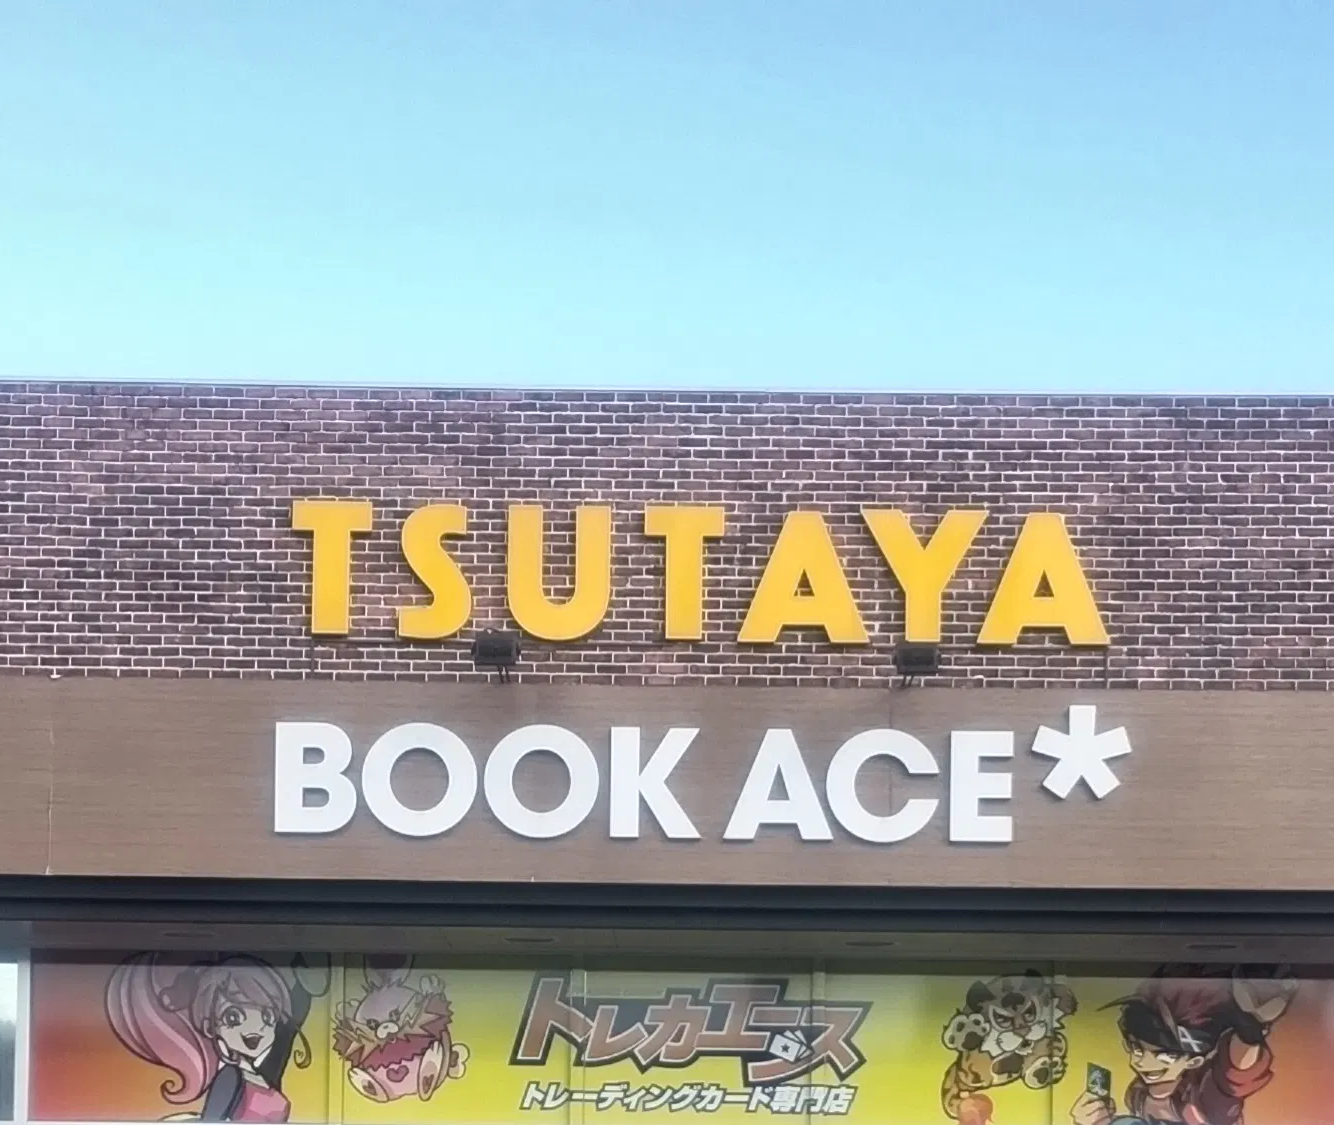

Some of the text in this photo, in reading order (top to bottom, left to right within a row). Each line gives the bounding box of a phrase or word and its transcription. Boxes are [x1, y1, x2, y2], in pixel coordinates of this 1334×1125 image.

[290, 500, 1110, 645] TSUTAYA
[273, 720, 702, 839] BOOK
[520, 1081, 858, 1115] トレーディングカード専門店
